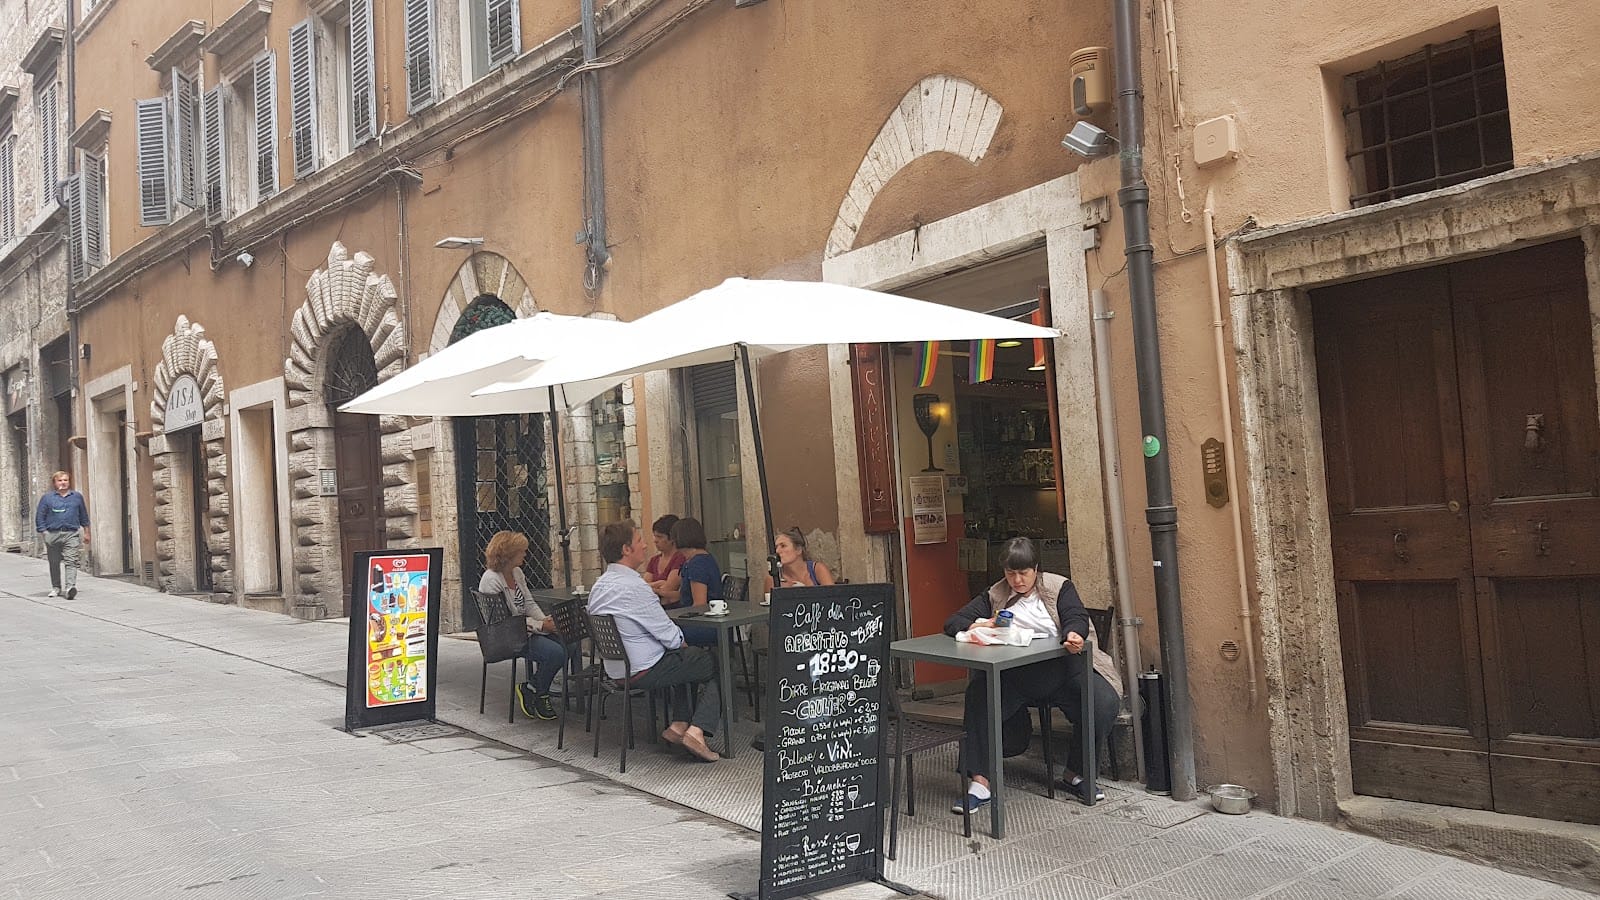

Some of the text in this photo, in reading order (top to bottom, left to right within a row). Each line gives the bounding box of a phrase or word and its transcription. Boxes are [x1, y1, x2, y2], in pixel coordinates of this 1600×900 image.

[1086, 206, 1101, 220] 24
[168, 384, 195, 411] AISA
[801, 777, 847, 798] Bianchi
